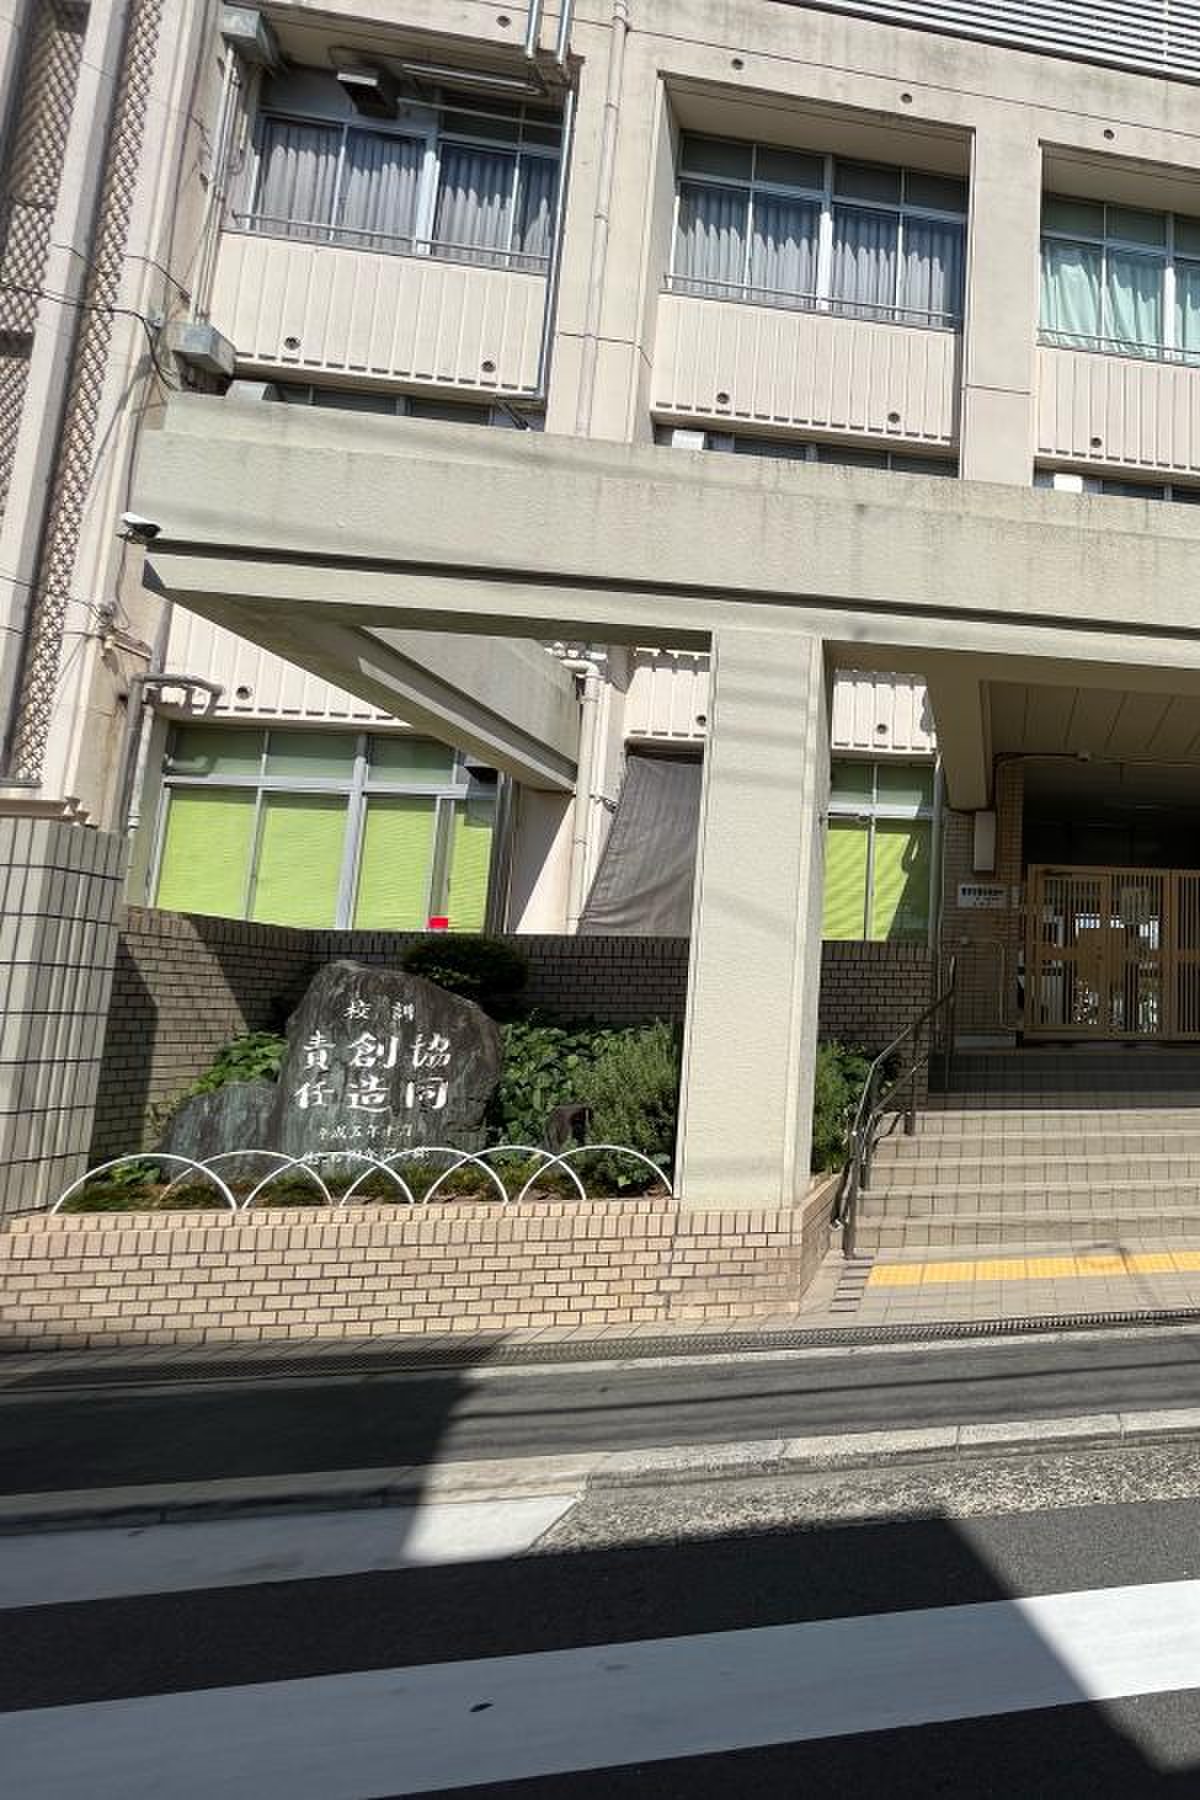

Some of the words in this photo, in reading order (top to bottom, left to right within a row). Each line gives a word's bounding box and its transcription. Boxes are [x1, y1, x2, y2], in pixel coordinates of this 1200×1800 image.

[344, 1000, 415, 1021] 校訓
[294, 1029, 336, 1109] 責任
[347, 1031, 399, 1112] 創造
[405, 1033, 450, 1110] 協同
